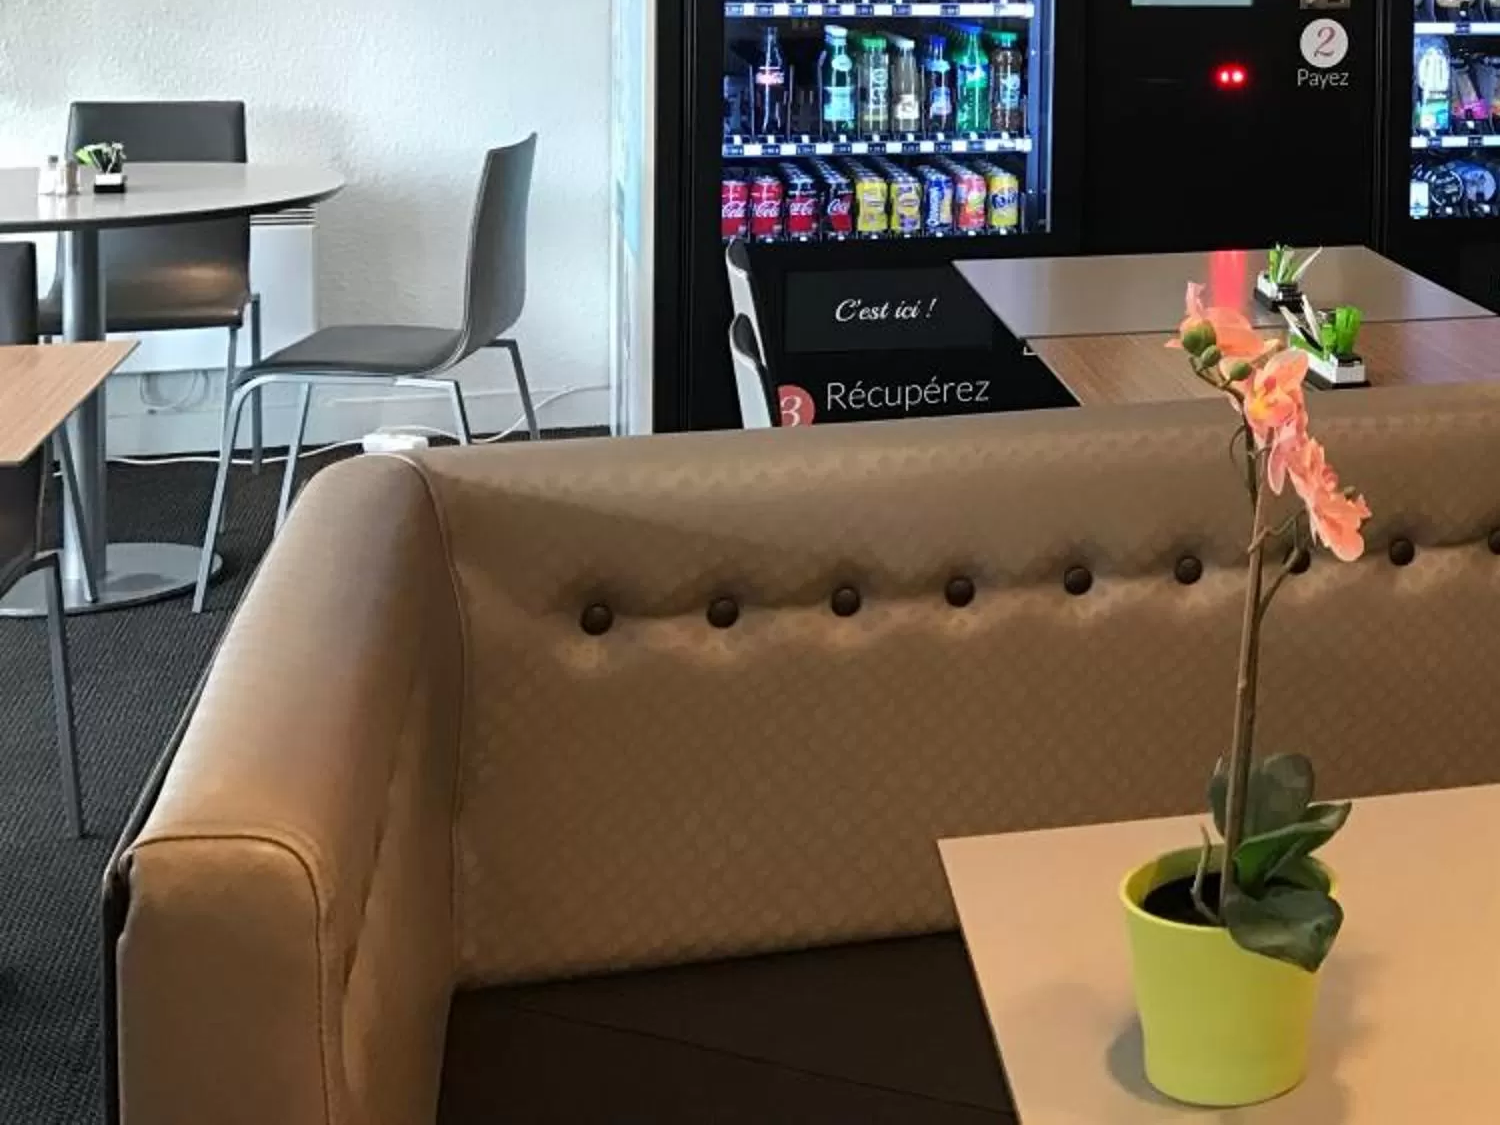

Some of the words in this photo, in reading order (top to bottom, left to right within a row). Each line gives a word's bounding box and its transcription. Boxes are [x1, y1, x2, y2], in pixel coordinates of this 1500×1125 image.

[1314, 26, 1336, 57] 2
[1297, 68, 1349, 90] Payez
[836, 298, 889, 322] C'est
[896, 300, 921, 319] ici
[780, 394, 801, 427] 3
[827, 376, 990, 412] Récupérez
